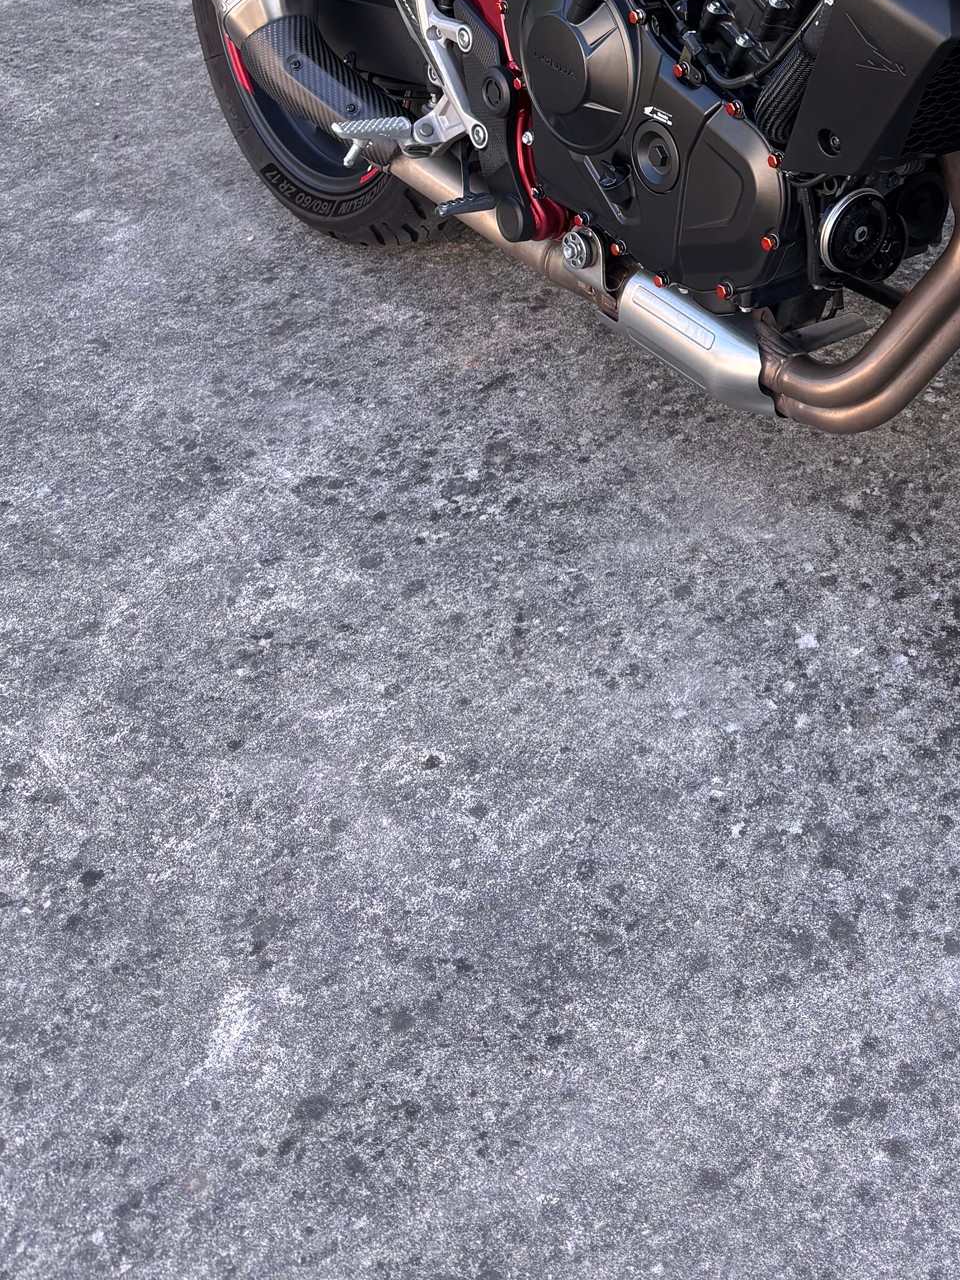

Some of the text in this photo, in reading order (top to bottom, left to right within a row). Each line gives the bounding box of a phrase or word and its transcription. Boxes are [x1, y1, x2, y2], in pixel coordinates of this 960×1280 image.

[265, 169, 333, 215] 160/60 ZR 17
